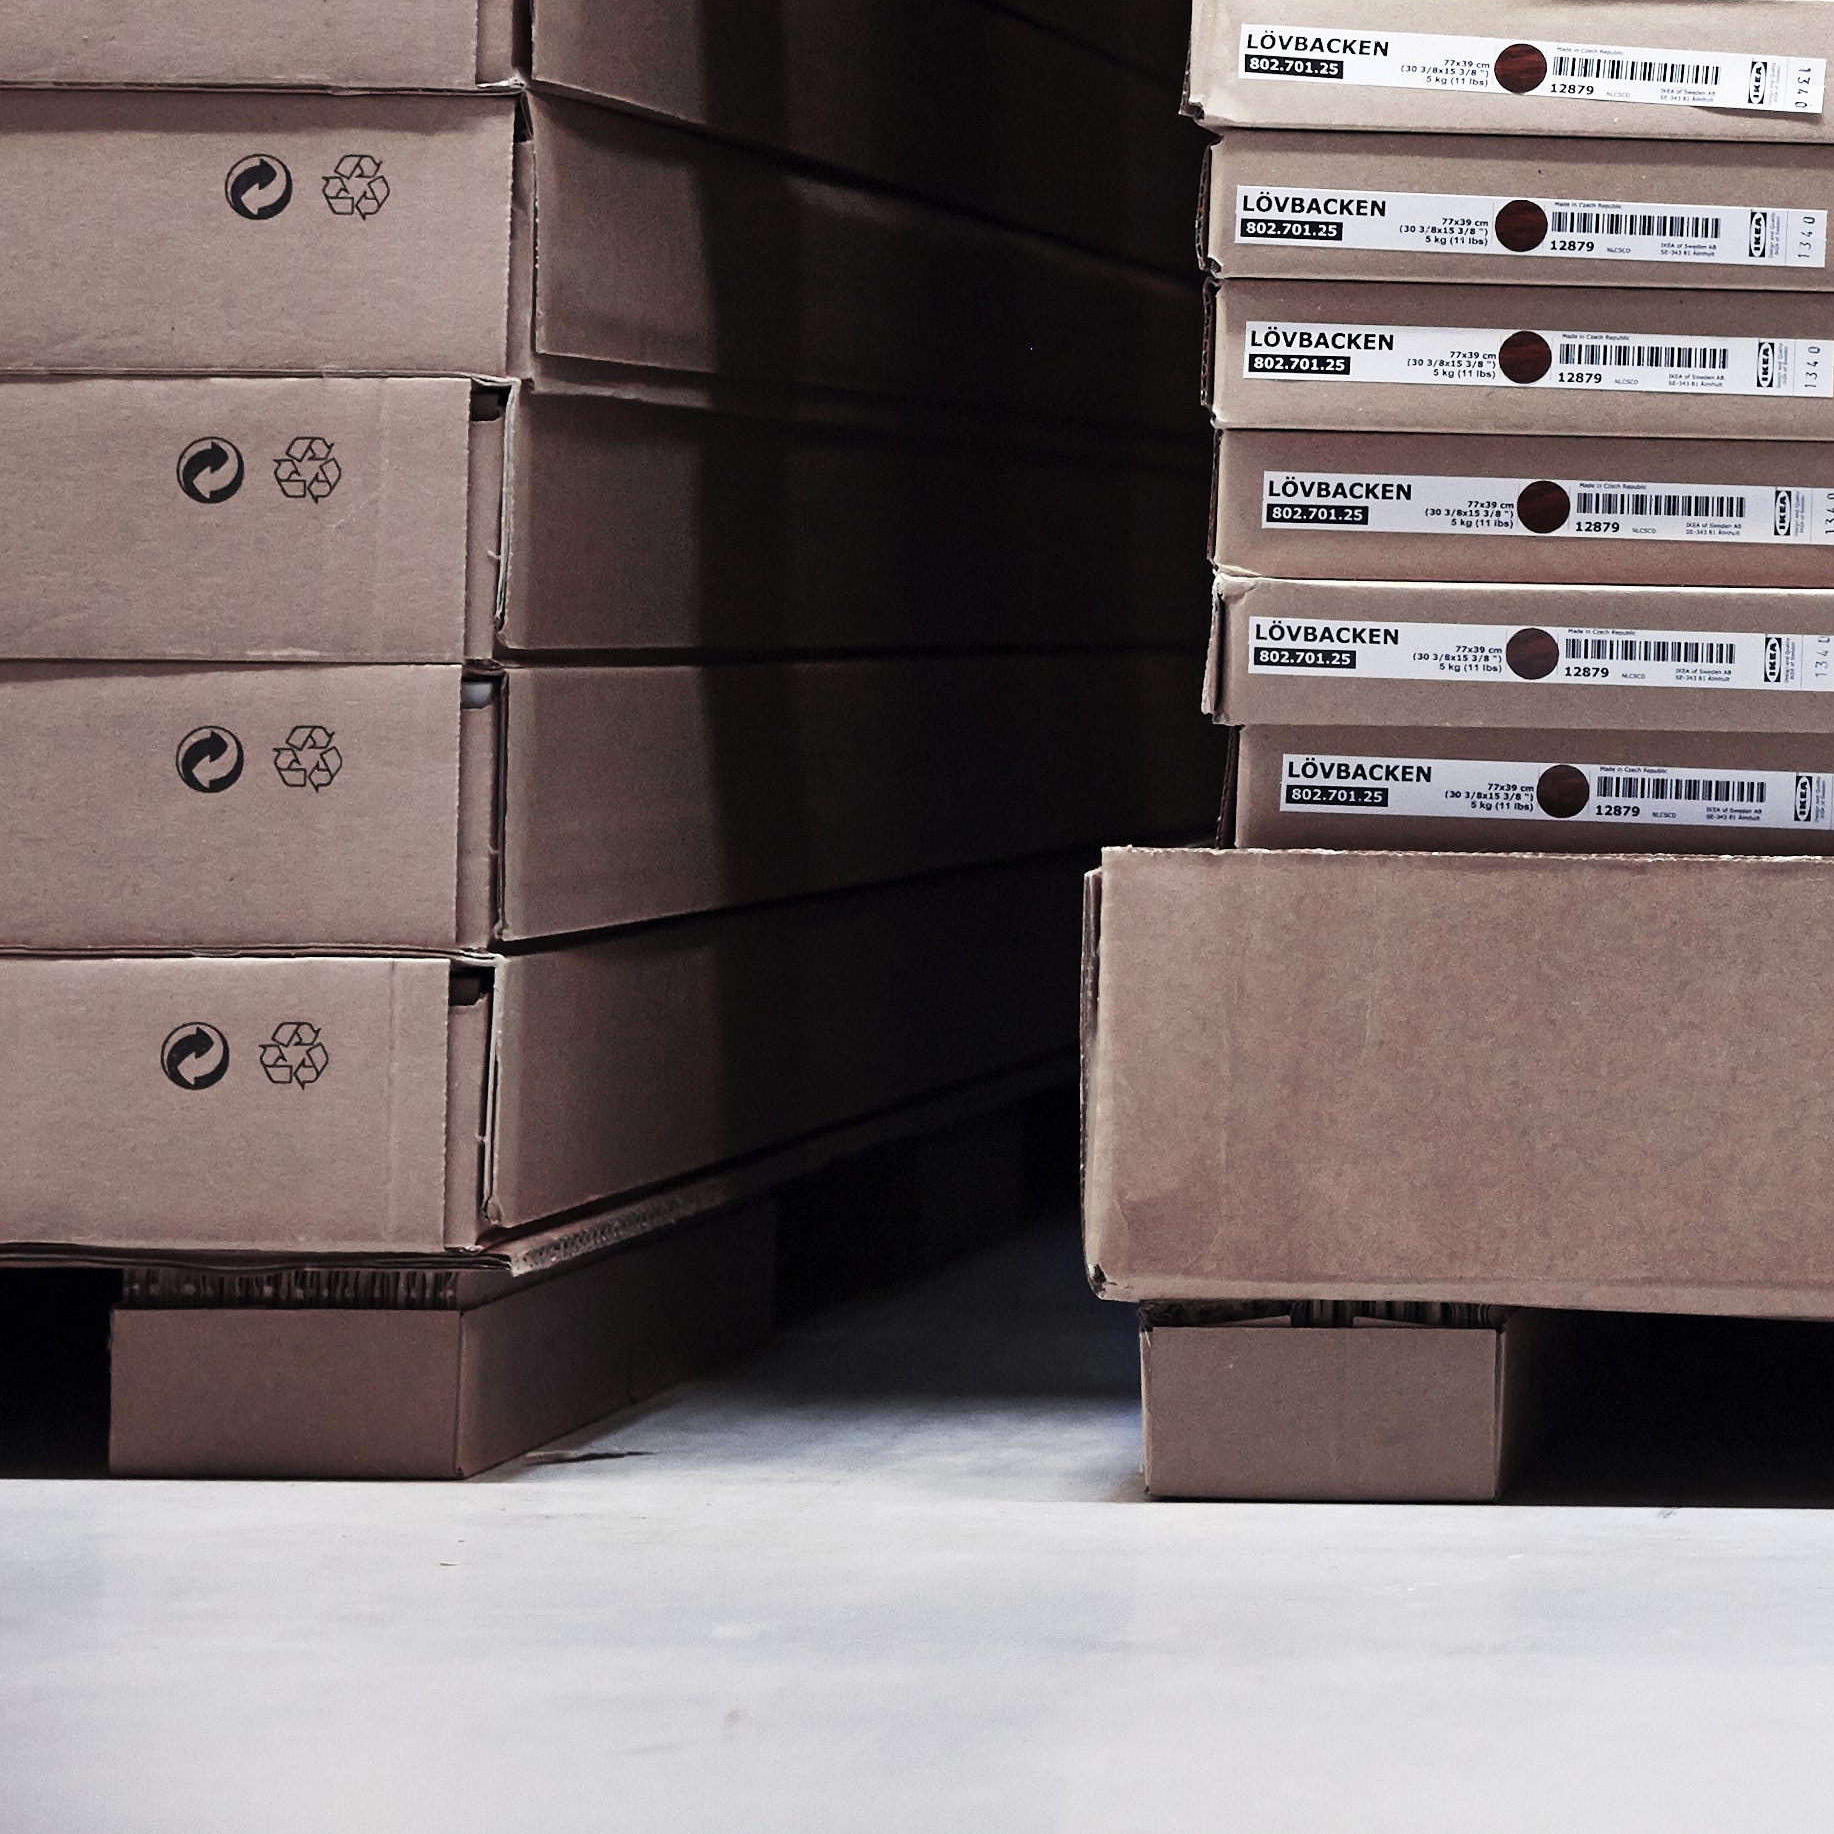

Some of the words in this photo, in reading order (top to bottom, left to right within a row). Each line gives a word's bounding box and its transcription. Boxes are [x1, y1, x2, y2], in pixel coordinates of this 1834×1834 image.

[1246, 29, 1389, 57] LÖVBACKEN
[1248, 56, 1339, 75] 802.701.25
[1443, 59, 1473, 67] 77x39
[1550, 83, 1594, 95] 12879
[1793, 67, 1812, 113] 1340
[1242, 190, 1386, 217] LÖVBACKEN
[1245, 221, 1337, 237] 802.701.25
[1441, 217, 1472, 226] 77x39
[1474, 219, 1489, 227] cm
[1797, 215, 1815, 258] 1340
[1550, 239, 1595, 252] 12879
[1250, 325, 1394, 351] LÖVBACKEN
[1449, 350, 1480, 359] 77x39
[1481, 352, 1497, 360] cm
[1253, 356, 1345, 371] 802.701.25
[1804, 346, 1820, 388] 1340
[1441, 368, 1455, 379] kg
[1558, 371, 1602, 384] 12879
[1268, 475, 1412, 501] LÖVBACKEN
[1467, 500, 1497, 509] 77x39
[1271, 506, 1363, 521] 802.701.25
[1575, 520, 1620, 533] 12879
[1255, 619, 1399, 645] LÖVBACKEN
[1455, 645, 1485, 654] 77x39
[1259, 649, 1351, 665] 802.701.25
[1447, 662, 1461, 673] kg
[1564, 666, 1609, 678] 12879
[1287, 756, 1432, 783] LÖVBACKEN
[1487, 782, 1518, 792] 77x39
[1291, 787, 1383, 803] 802.701.25
[1479, 800, 1493, 811] kg
[1595, 804, 1640, 817] 12879
